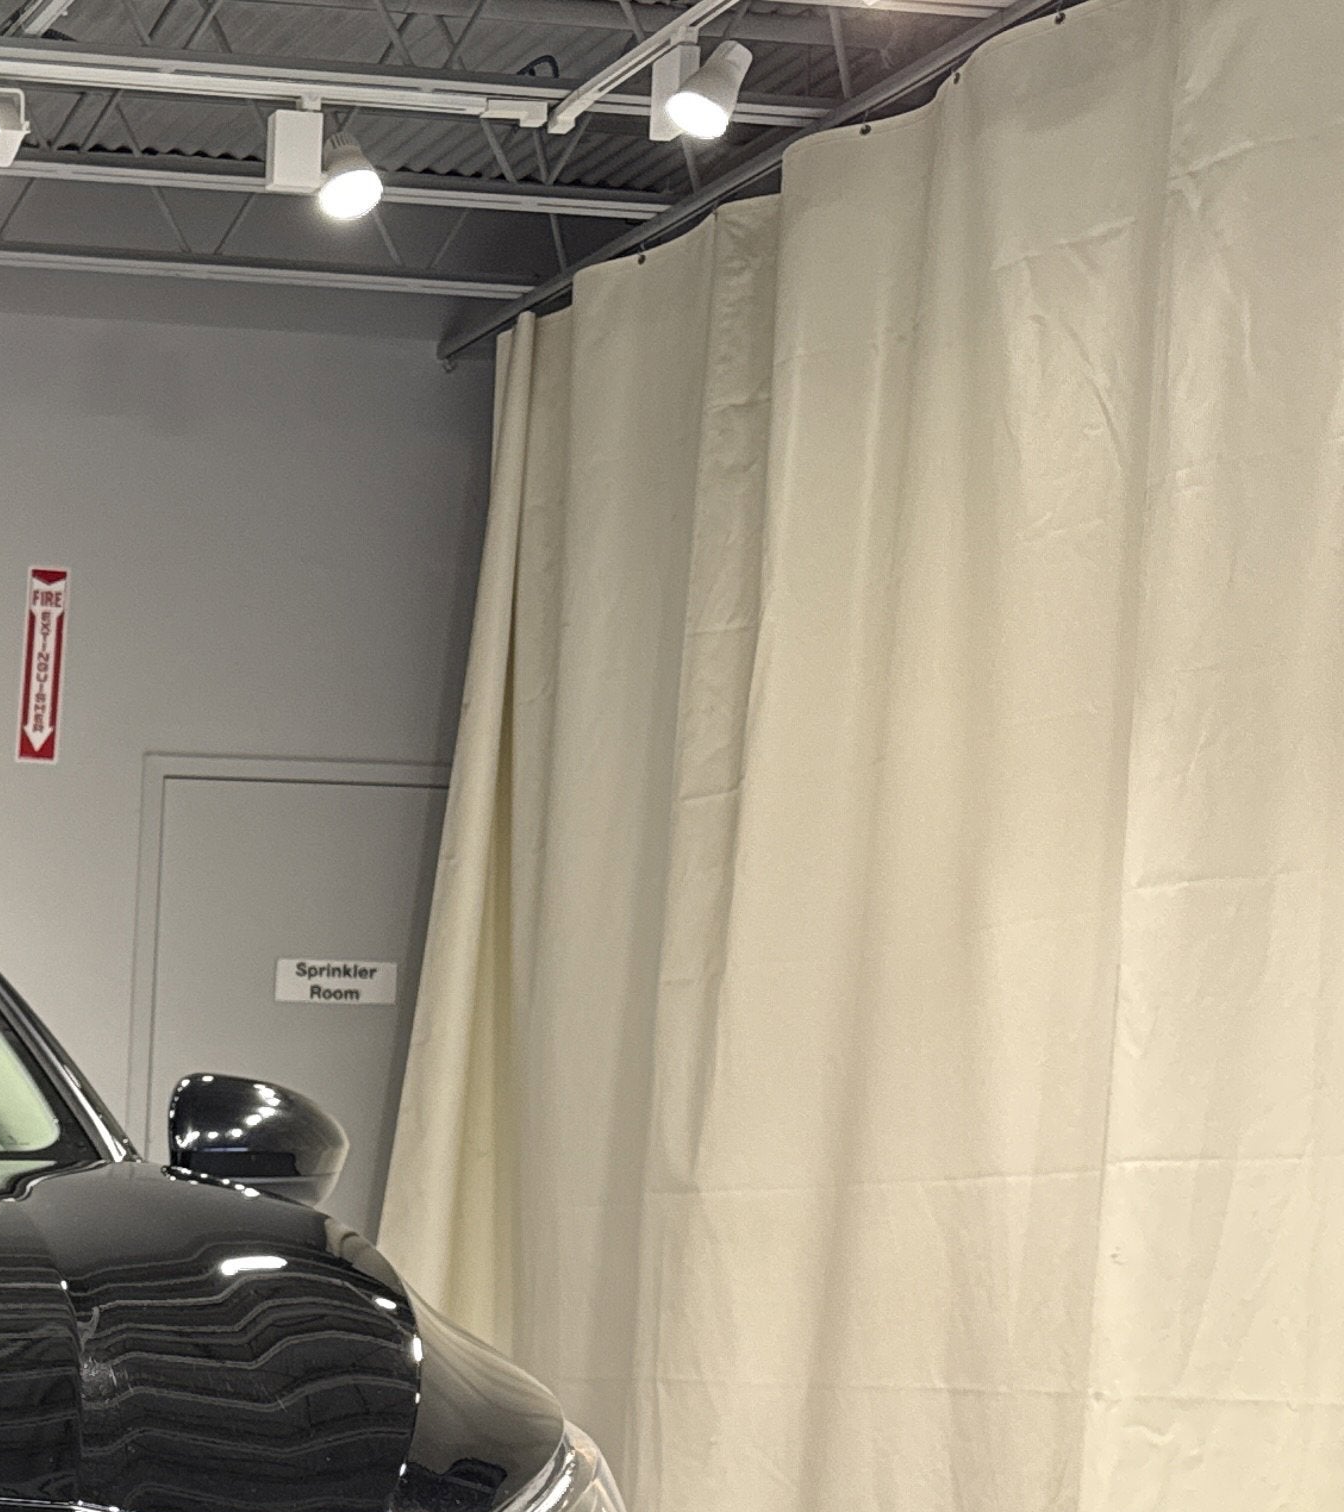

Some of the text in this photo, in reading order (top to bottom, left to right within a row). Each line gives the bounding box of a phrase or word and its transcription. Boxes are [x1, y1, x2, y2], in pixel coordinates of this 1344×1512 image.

[32, 591, 62, 607] FIRE
[296, 962, 377, 979] Sprinkler
[310, 985, 360, 1000] Room
